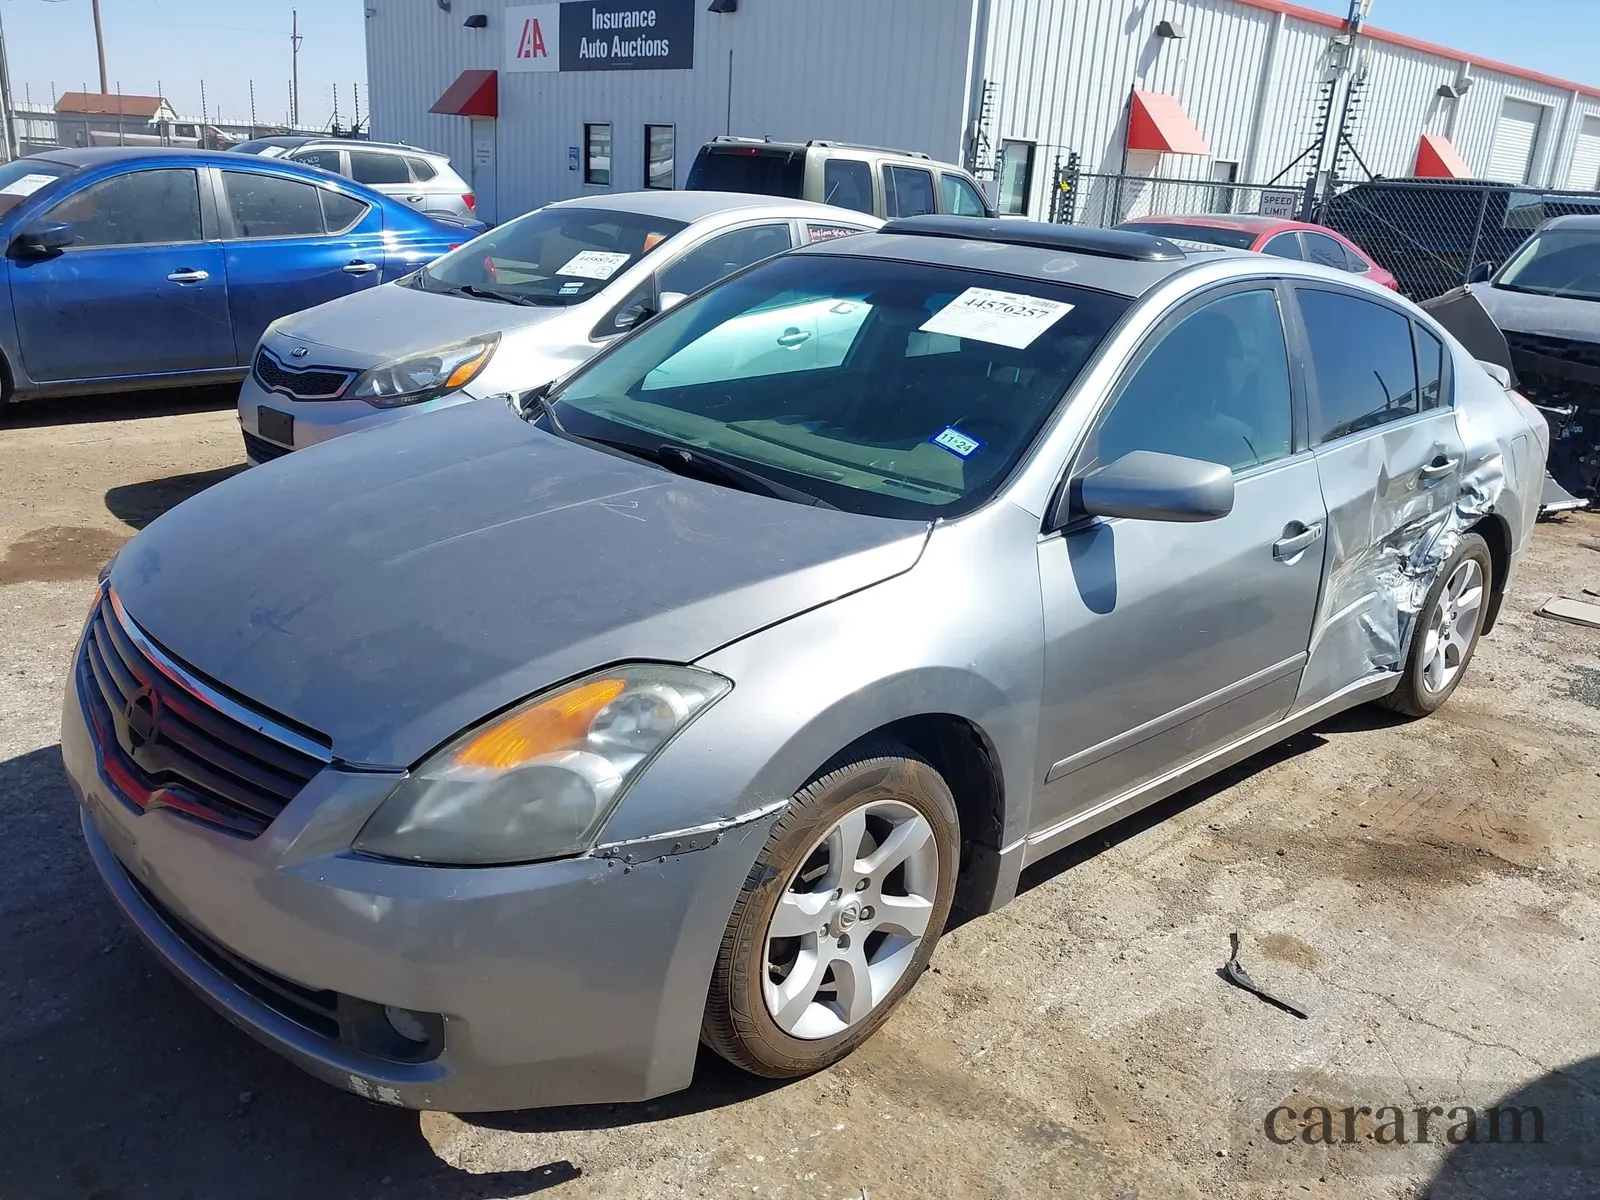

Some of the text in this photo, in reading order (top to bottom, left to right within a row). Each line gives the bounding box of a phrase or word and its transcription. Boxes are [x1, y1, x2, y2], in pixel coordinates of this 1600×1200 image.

[592, 8, 656, 30] Insurance
[579, 34, 669, 59] Auto Auctions
[1264, 196, 1292, 205] SPEED
[1264, 207, 1288, 216] LIMIT
[963, 297, 1050, 319] 44576257
